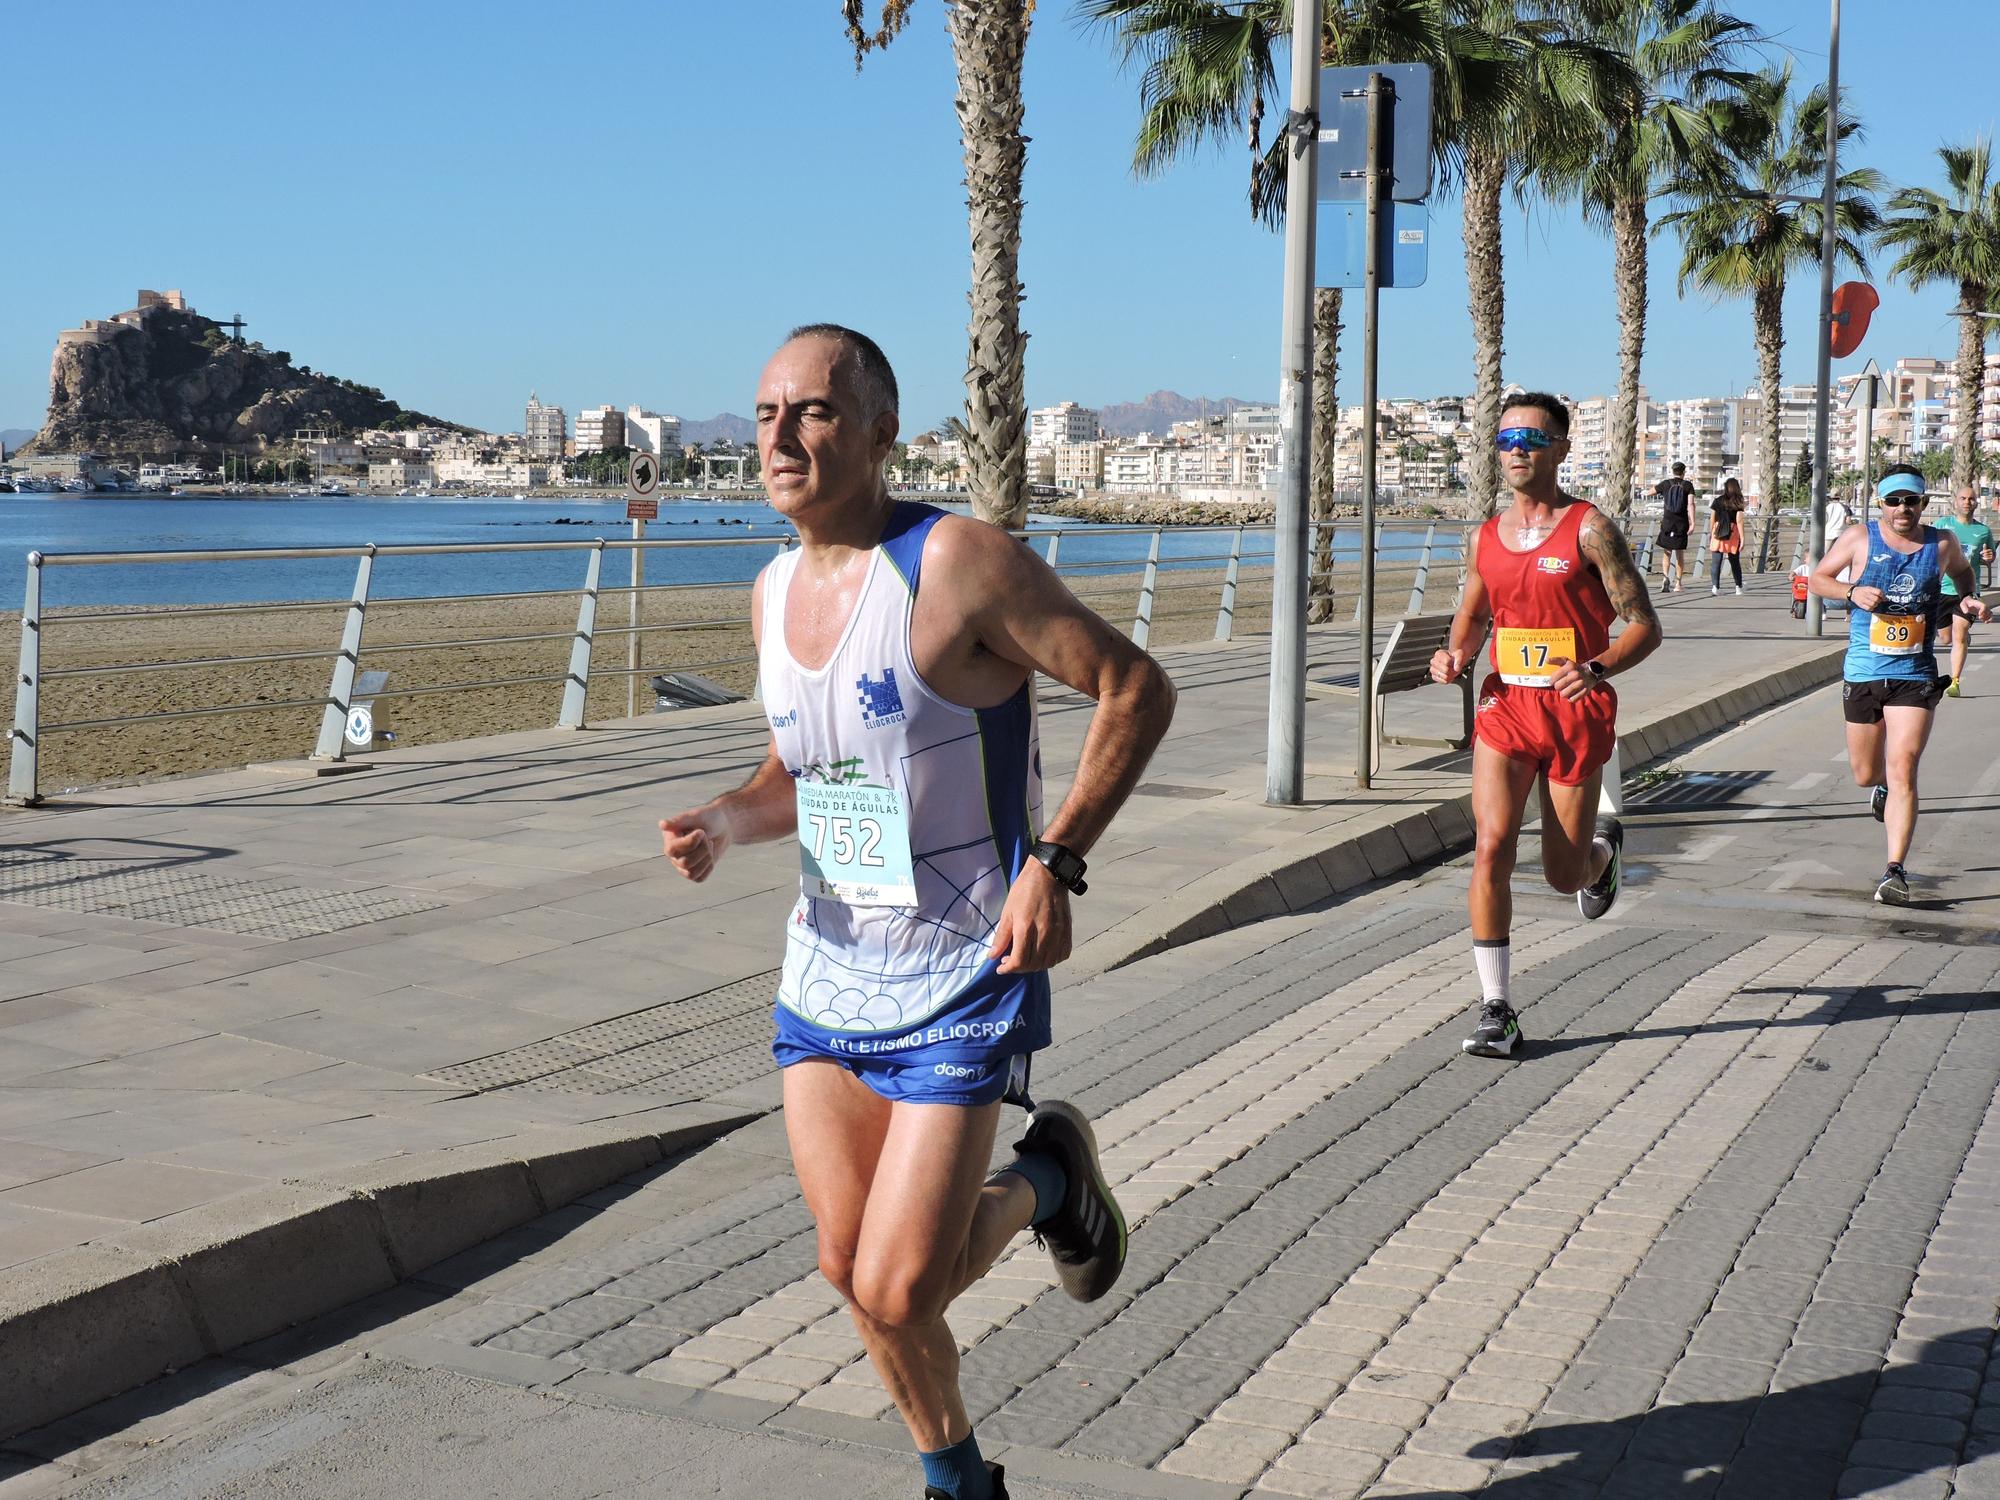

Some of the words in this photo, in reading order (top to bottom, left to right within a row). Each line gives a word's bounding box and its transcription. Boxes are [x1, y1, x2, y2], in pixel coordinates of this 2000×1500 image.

[1886, 626, 1909, 642] 89
[1520, 644, 1549, 668] 17
[865, 712, 907, 730] ELIOCROCA
[824, 790, 869, 801] MARATÓN
[801, 796, 829, 810] CIUDAD
[833, 801, 847, 811] DE
[852, 801, 899, 815] ÁGUILAS
[809, 814, 884, 867] 752
[829, 1032, 922, 1054] ATLETISMO
